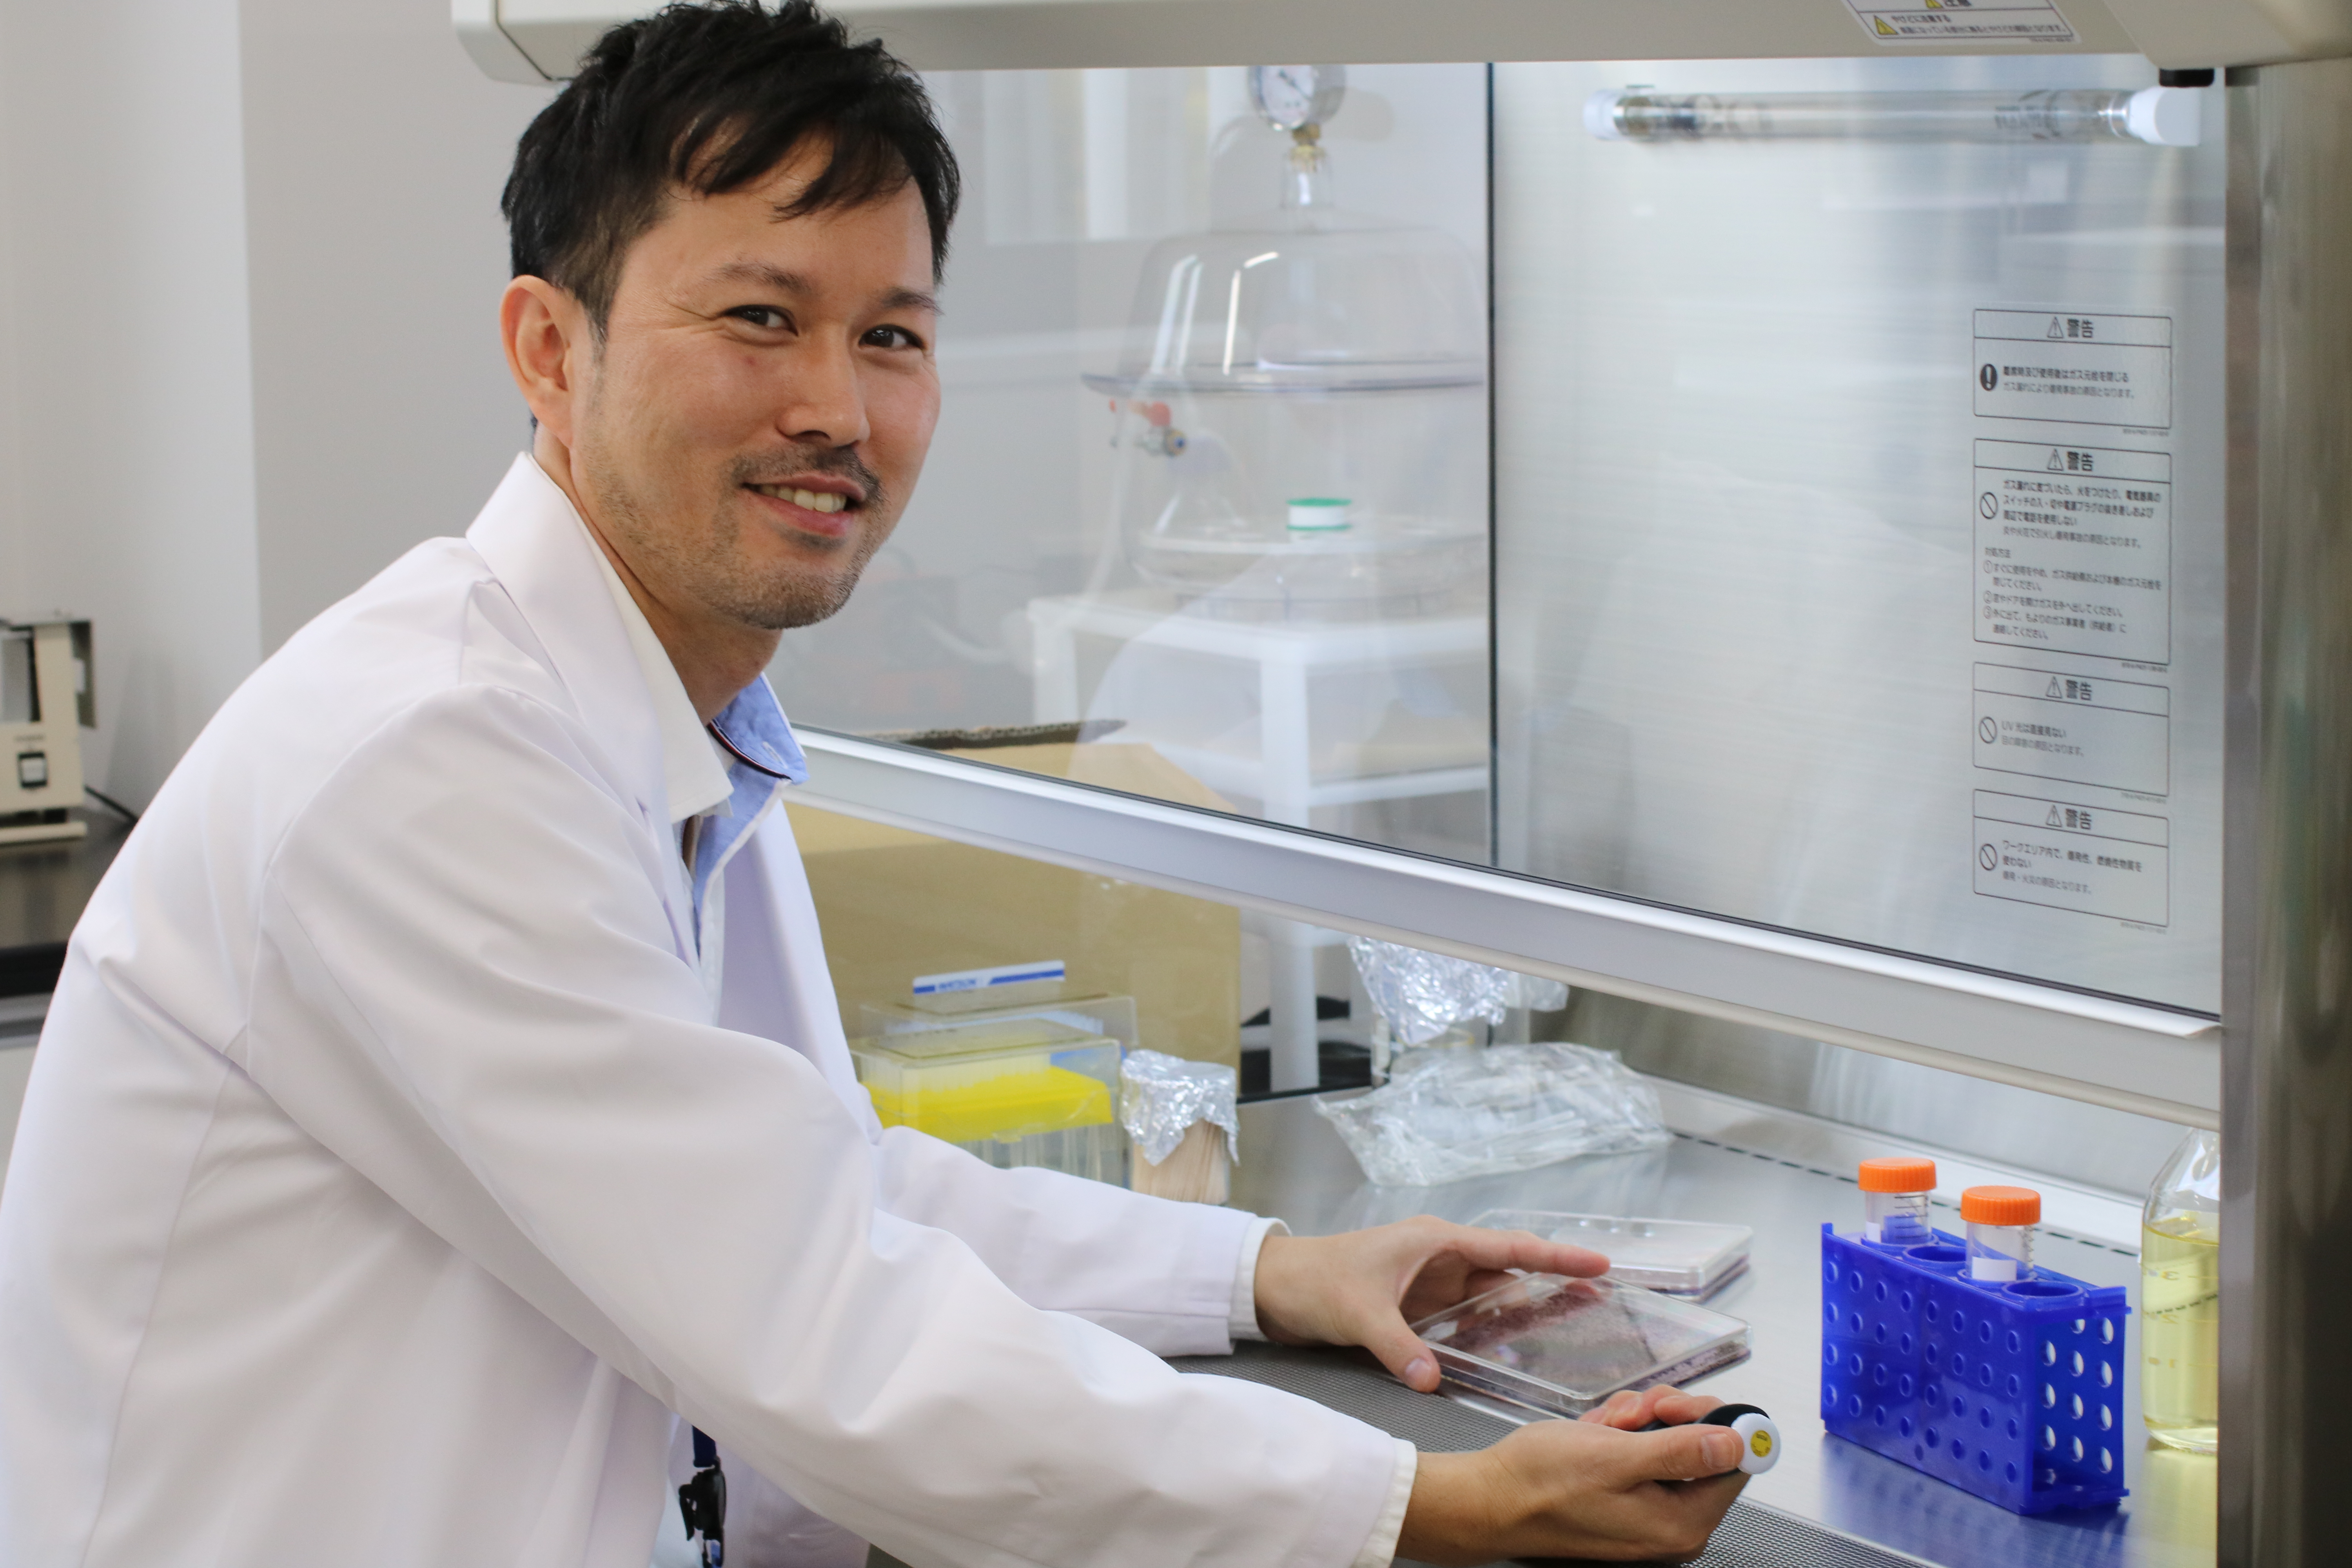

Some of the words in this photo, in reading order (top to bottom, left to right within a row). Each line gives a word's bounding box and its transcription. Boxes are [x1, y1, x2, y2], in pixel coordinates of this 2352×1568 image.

[2067, 318, 2094, 338] 警告
[2067, 451, 2094, 472] 警告
[2065, 679, 2092, 701] 警告
[2065, 808, 2092, 830] 警告
